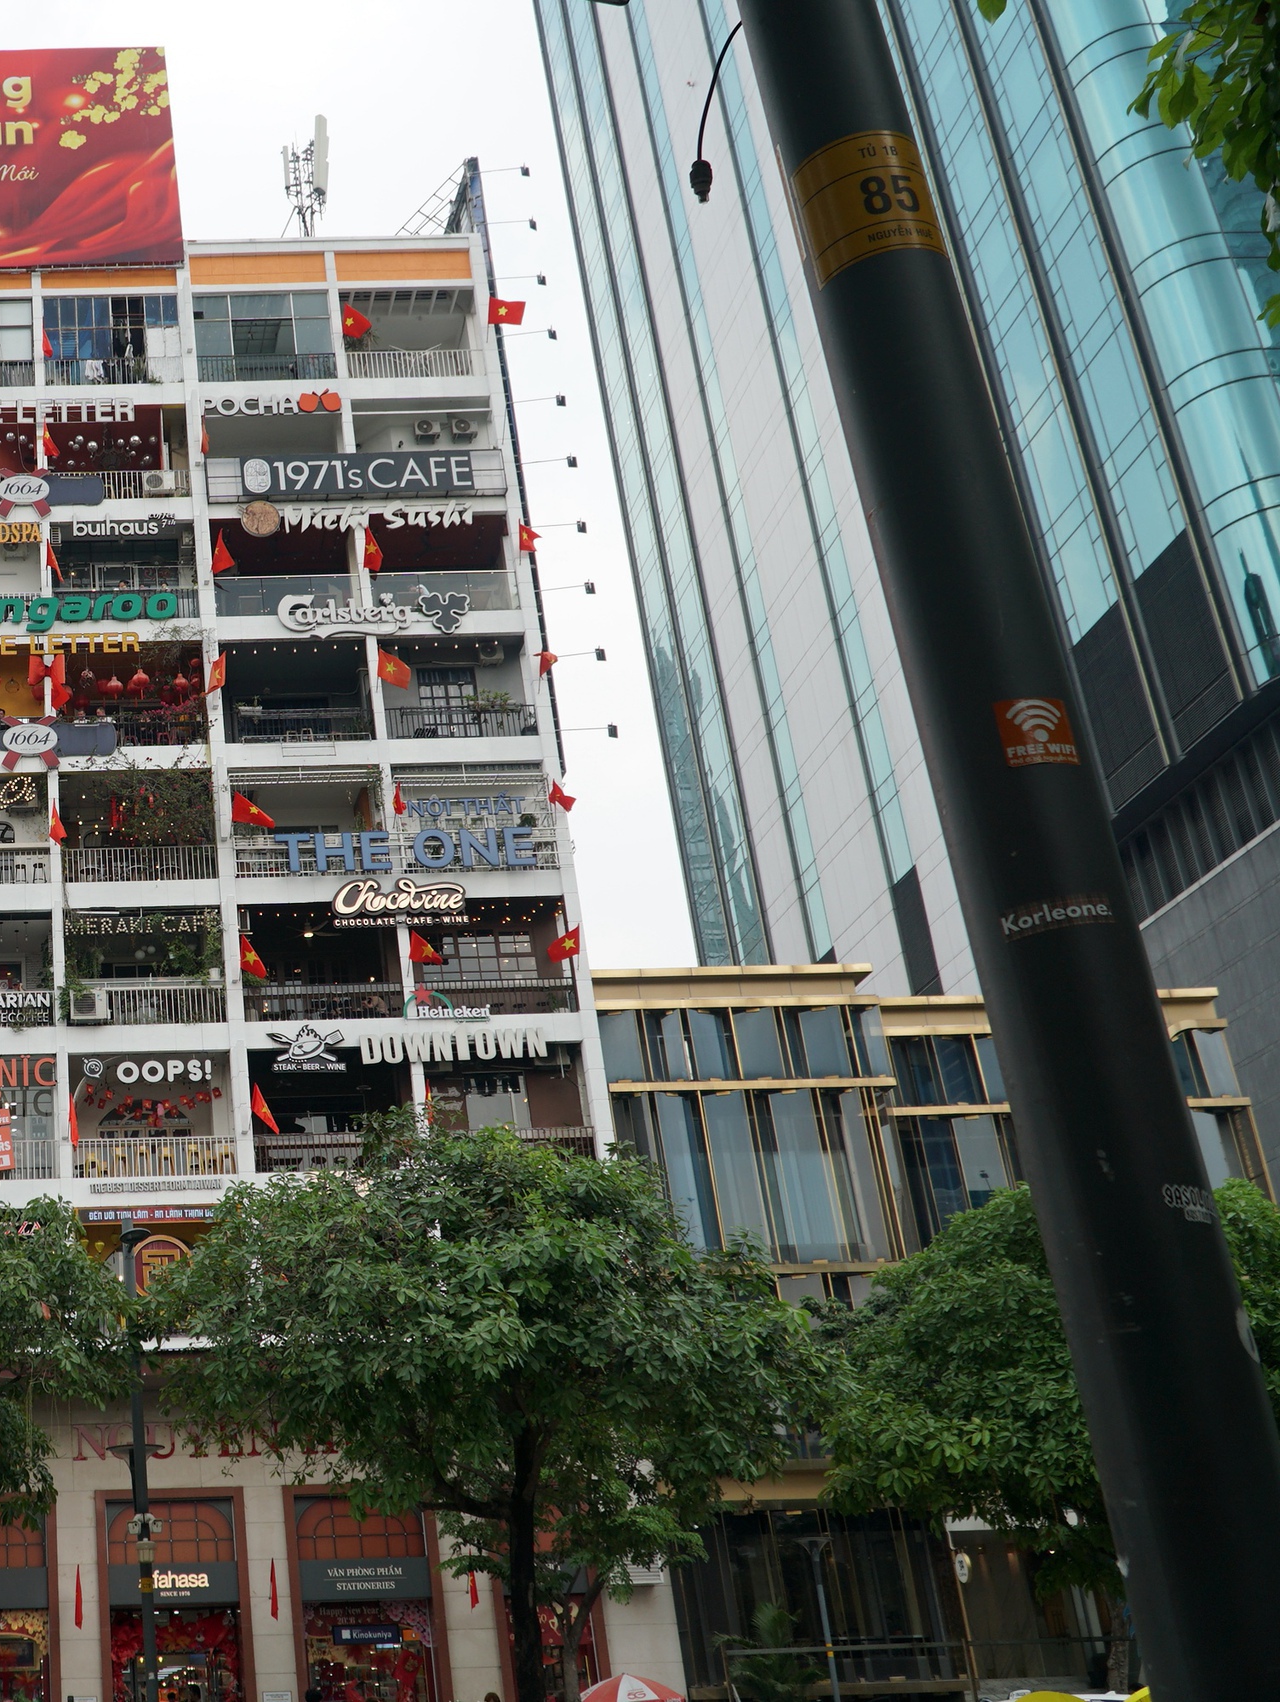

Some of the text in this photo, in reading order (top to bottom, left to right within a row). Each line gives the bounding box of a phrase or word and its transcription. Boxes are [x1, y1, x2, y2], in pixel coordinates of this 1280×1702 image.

[860, 174, 920, 215] 85
[867, 224, 913, 243] NGUYỄN
[17, 397, 136, 424] LETTER
[202, 393, 299, 417] POCHA
[272, 455, 473, 493] 1971's CAFE
[2, 480, 44, 496] 1664
[72, 514, 159, 538] buihaus
[284, 500, 474, 534] Michi Sushi
[277, 594, 413, 634] Carlsberg
[29, 632, 140, 654] LETTER
[8, 731, 51, 747] 1664
[1006, 743, 1076, 759] FREE WIFI
[275, 826, 537, 872] THE ONE
[65, 916, 153, 936] MERAKI
[334, 913, 470, 927] CHOCOLATE CAFE WINE
[418, 1004, 490, 1019] Heineken
[360, 1027, 549, 1065] DOWNTOWN
[116, 1059, 213, 1084] OOPS!
[273, 1062, 346, 1071] STEAK BEER WINE
[151, 1570, 210, 1589] fahasa
[327, 1568, 345, 1577] VĂN
[346, 1567, 375, 1576] PHÒNG
[336, 1581, 396, 1591] STATIONERIES
[320, 1607, 343, 1617] Happy
[352, 1631, 392, 1639] Kinokuniya
